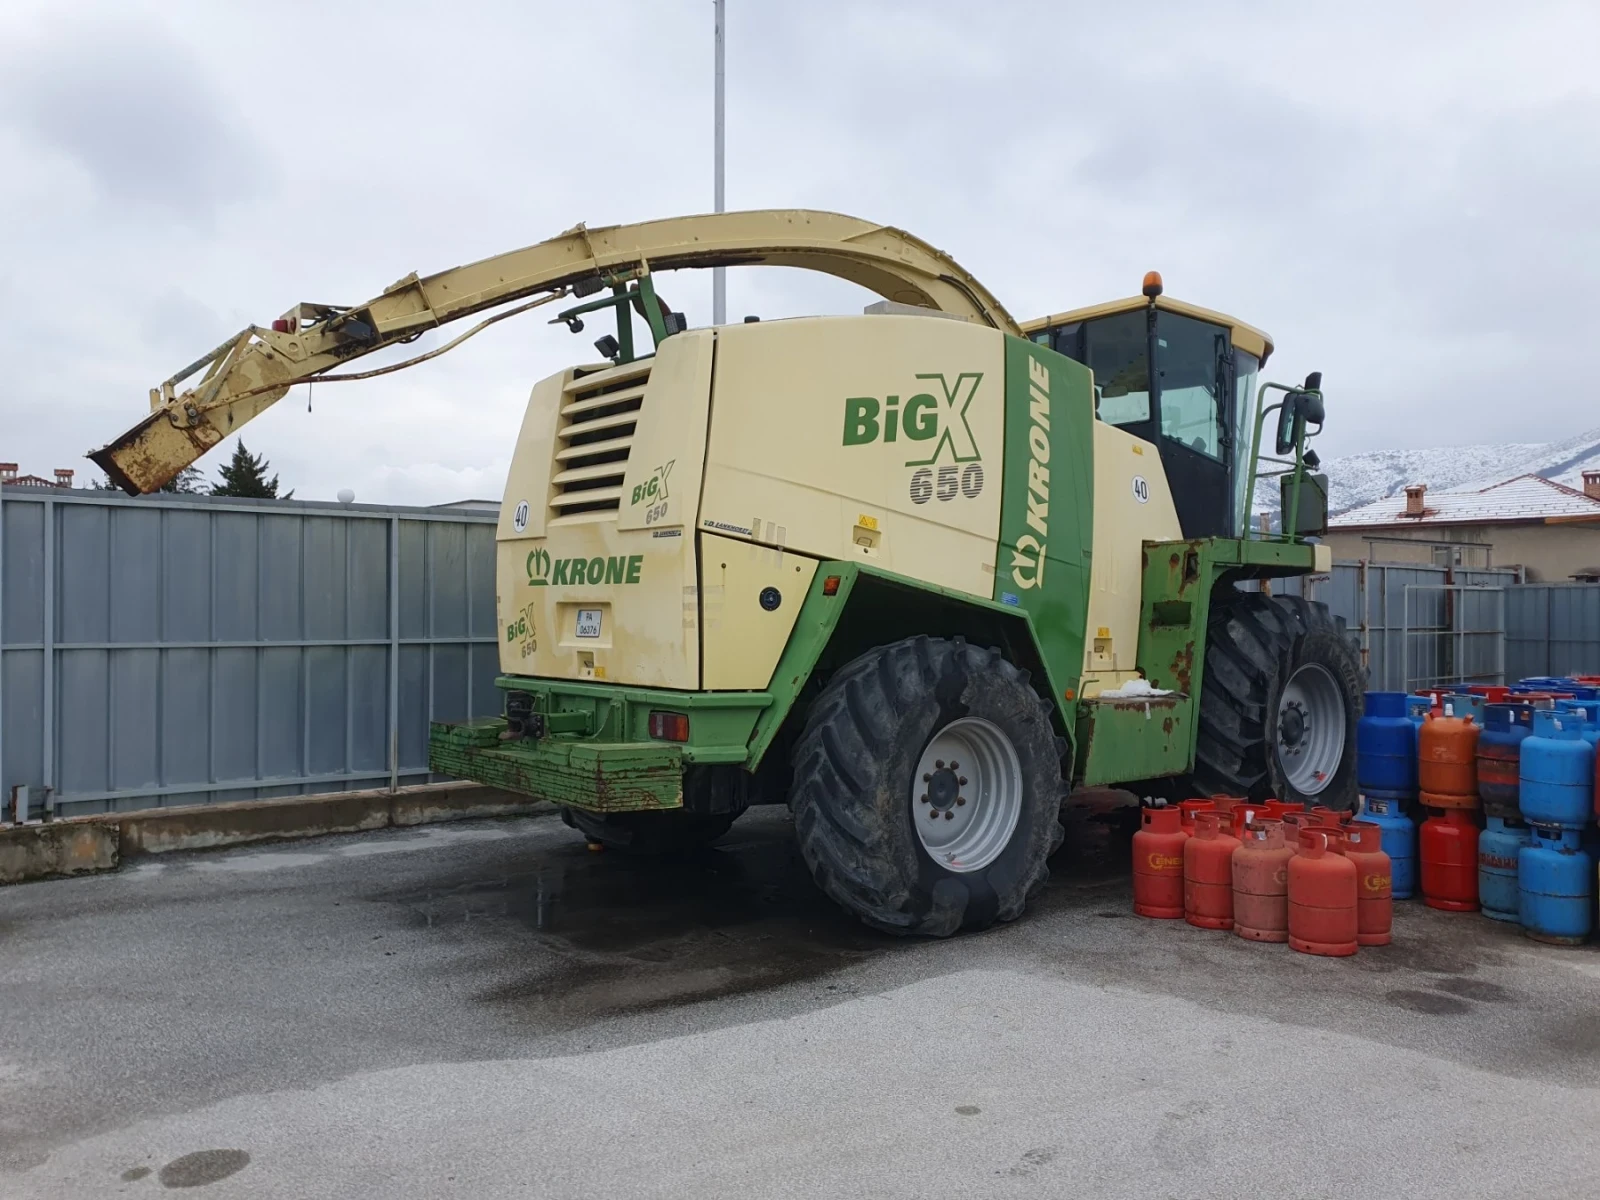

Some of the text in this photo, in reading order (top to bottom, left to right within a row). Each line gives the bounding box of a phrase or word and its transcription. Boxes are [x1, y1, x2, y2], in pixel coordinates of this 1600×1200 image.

[1026, 354, 1050, 537] KRONE
[909, 463, 984, 505] 650
[1134, 481, 1147, 500] 40
[515, 504, 528, 527] 40
[646, 502, 668, 526] 650
[552, 555, 644, 585] KRONE
[522, 639, 537, 659] 650
